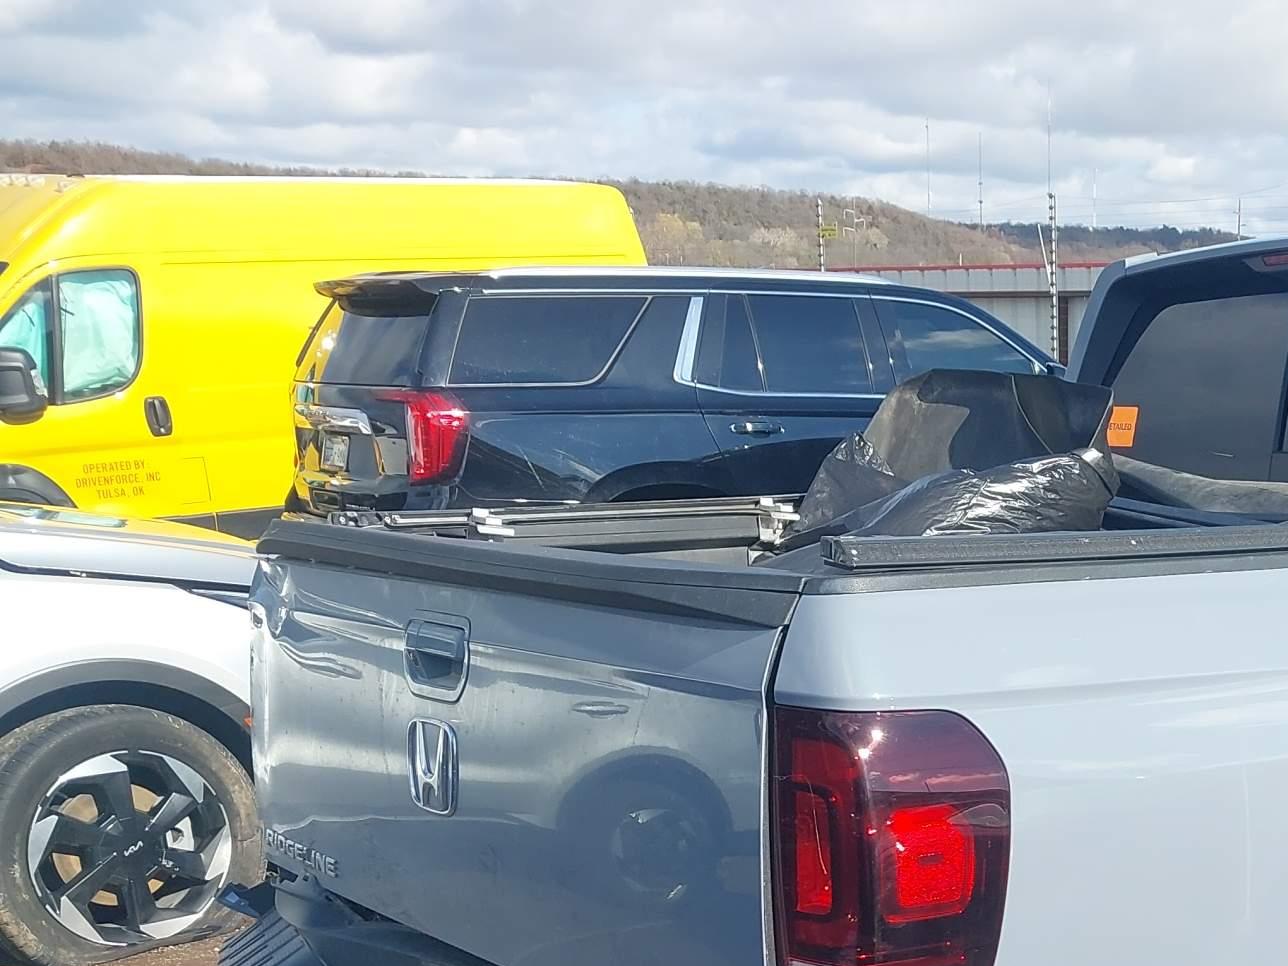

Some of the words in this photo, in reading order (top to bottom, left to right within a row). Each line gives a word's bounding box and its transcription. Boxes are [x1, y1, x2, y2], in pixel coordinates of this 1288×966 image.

[1108, 422, 1132, 431] ETAILED
[83, 460, 131, 474] OPERATED
[134, 459, 145, 470] BY
[146, 471, 161, 482] INC
[132, 485, 145, 497] OK
[265, 828, 338, 878] RIDGELINE
